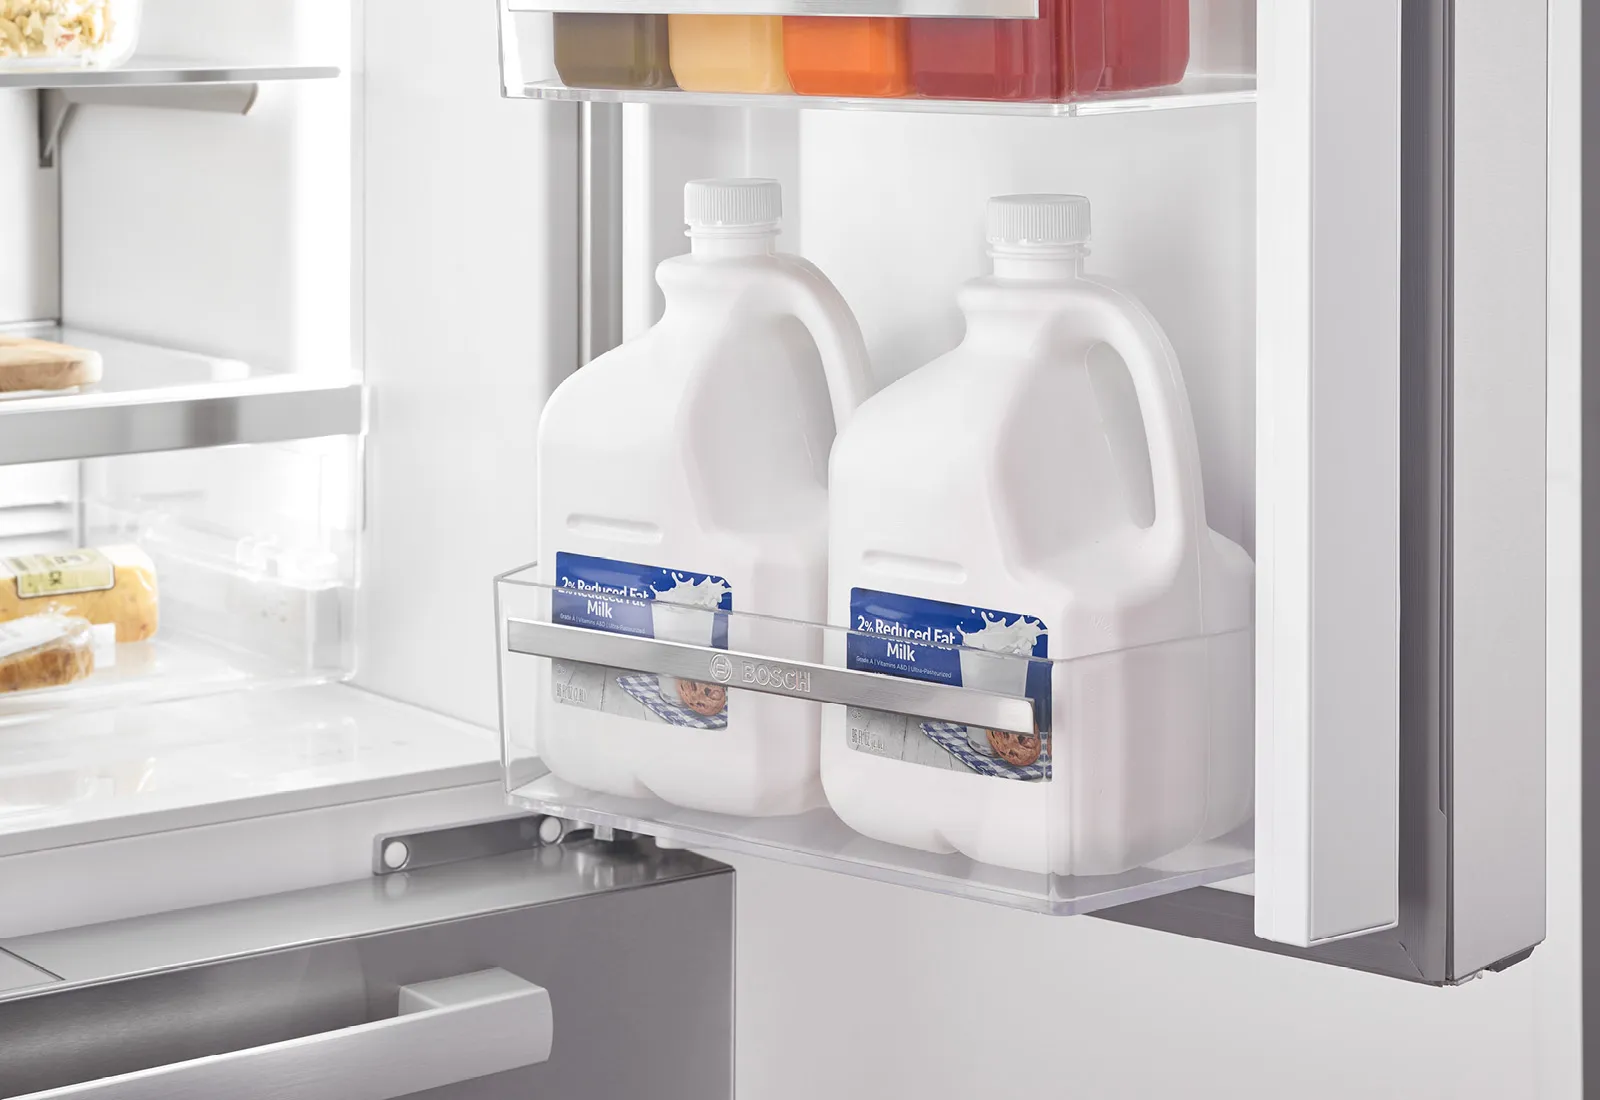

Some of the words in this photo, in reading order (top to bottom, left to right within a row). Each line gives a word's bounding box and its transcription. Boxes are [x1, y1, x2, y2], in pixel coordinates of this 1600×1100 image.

[576, 579, 627, 603] Reduced
[626, 587, 649, 607] Fat
[587, 599, 613, 619] Milk
[857, 615, 875, 635] 2%
[875, 618, 931, 645] Reduced
[932, 628, 956, 651] Fat
[856, 655, 869, 663] Grade
[877, 659, 896, 669] Vitamins
[896, 664, 908, 672] A&D
[886, 641, 916, 663] Milk
[741, 661, 811, 693] BOSCH
